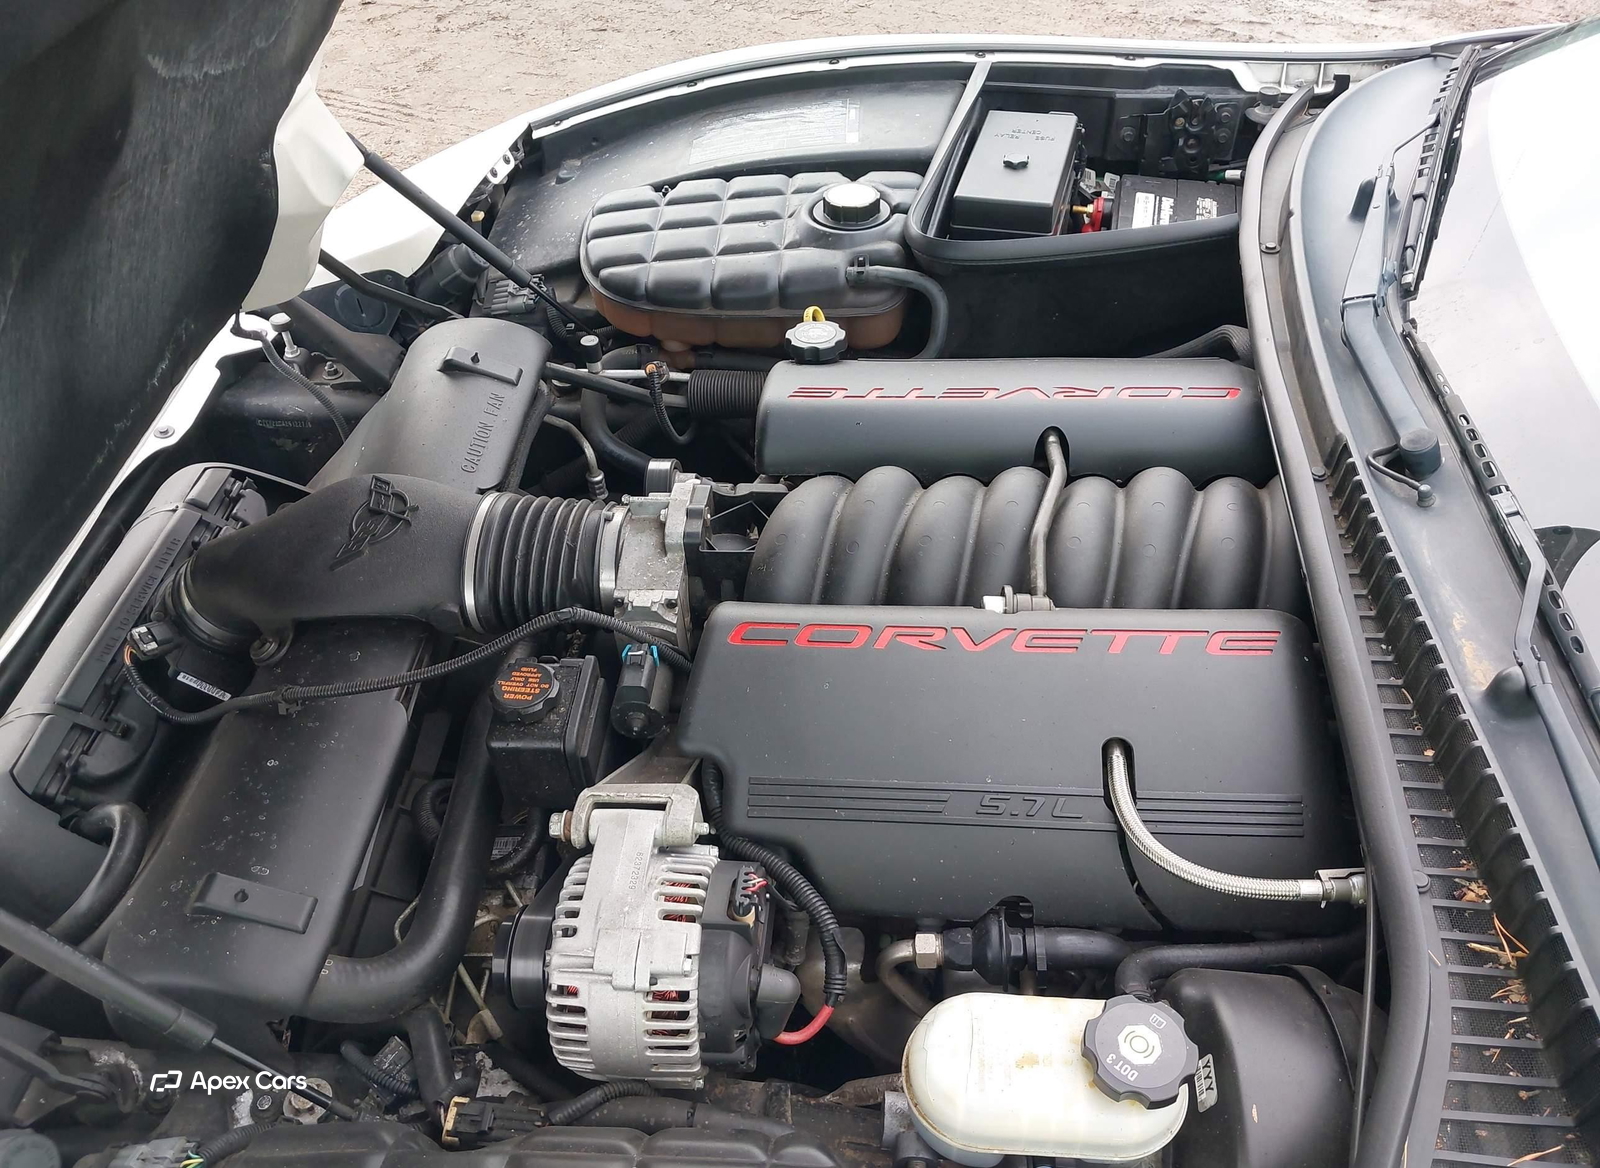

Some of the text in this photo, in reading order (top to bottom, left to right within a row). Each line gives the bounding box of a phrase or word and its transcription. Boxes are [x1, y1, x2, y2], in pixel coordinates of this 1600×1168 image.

[787, 386, 1242, 400] CORVETTE
[460, 392, 505, 474] CAUTION FAN
[97, 537, 181, 663] PULL TO SERVICE FILTER
[727, 620, 1282, 656] CORVETTE
[501, 685, 541, 694] STEERING
[976, 794, 1083, 819] 5.7L
[1105, 1053, 1139, 1081] DOT 3
[1202, 1058, 1214, 1092] YYY
